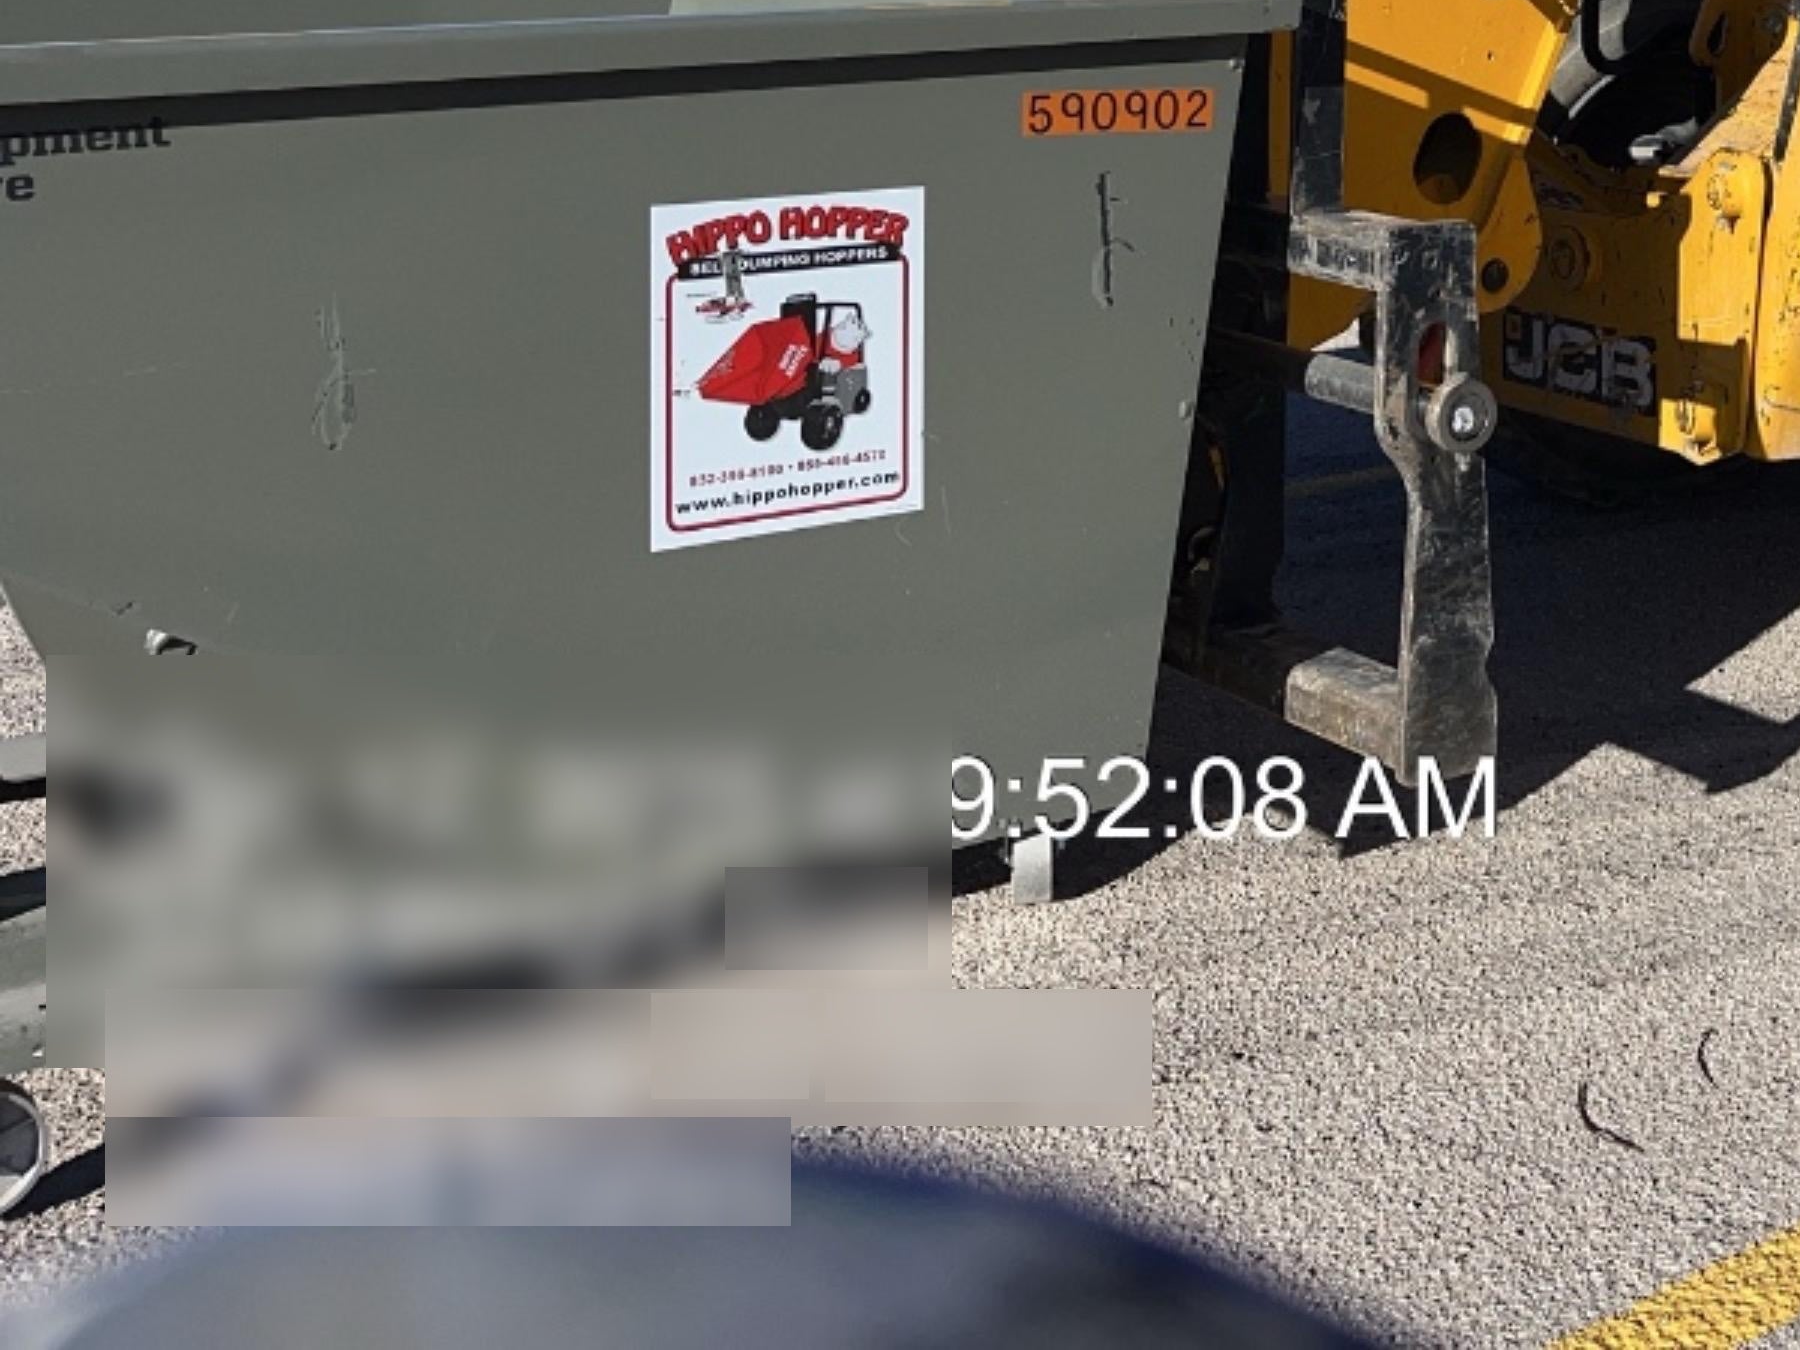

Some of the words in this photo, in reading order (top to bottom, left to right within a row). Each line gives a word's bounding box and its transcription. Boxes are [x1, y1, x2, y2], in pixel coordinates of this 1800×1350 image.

[1029, 89, 1208, 135] 590902
[665, 210, 772, 267] HIPPO
[779, 204, 910, 247] HOPPER
[814, 245, 888, 266] HOPPERS
[1504, 319, 1655, 407] JCB
[675, 470, 900, 516] www.hippohopper.com
